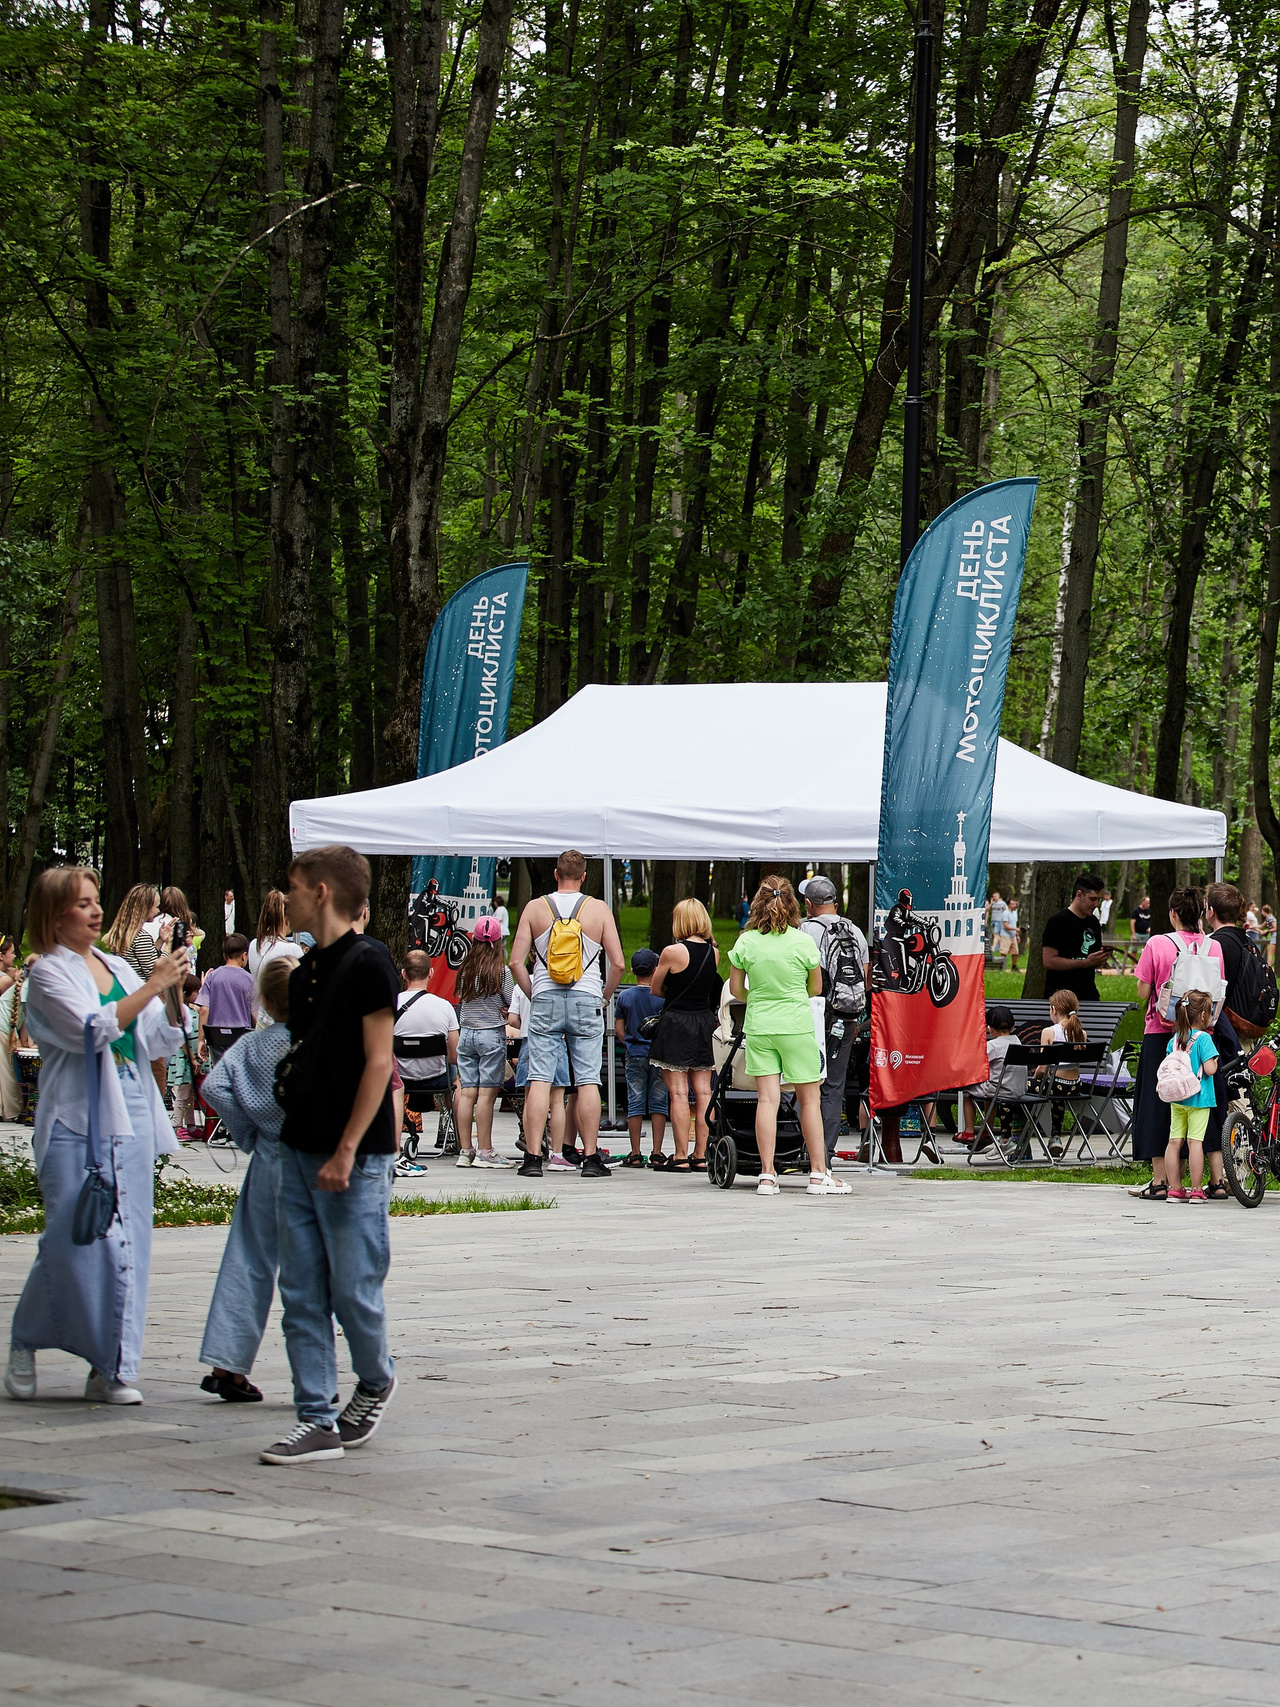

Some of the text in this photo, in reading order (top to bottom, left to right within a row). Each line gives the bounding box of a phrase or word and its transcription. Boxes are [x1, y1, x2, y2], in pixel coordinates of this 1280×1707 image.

[956, 520, 986, 600] ДЕНЬ
[467, 596, 489, 659] ДЕНЬ
[956, 514, 1012, 764] МОТОЦИКЛИСТА
